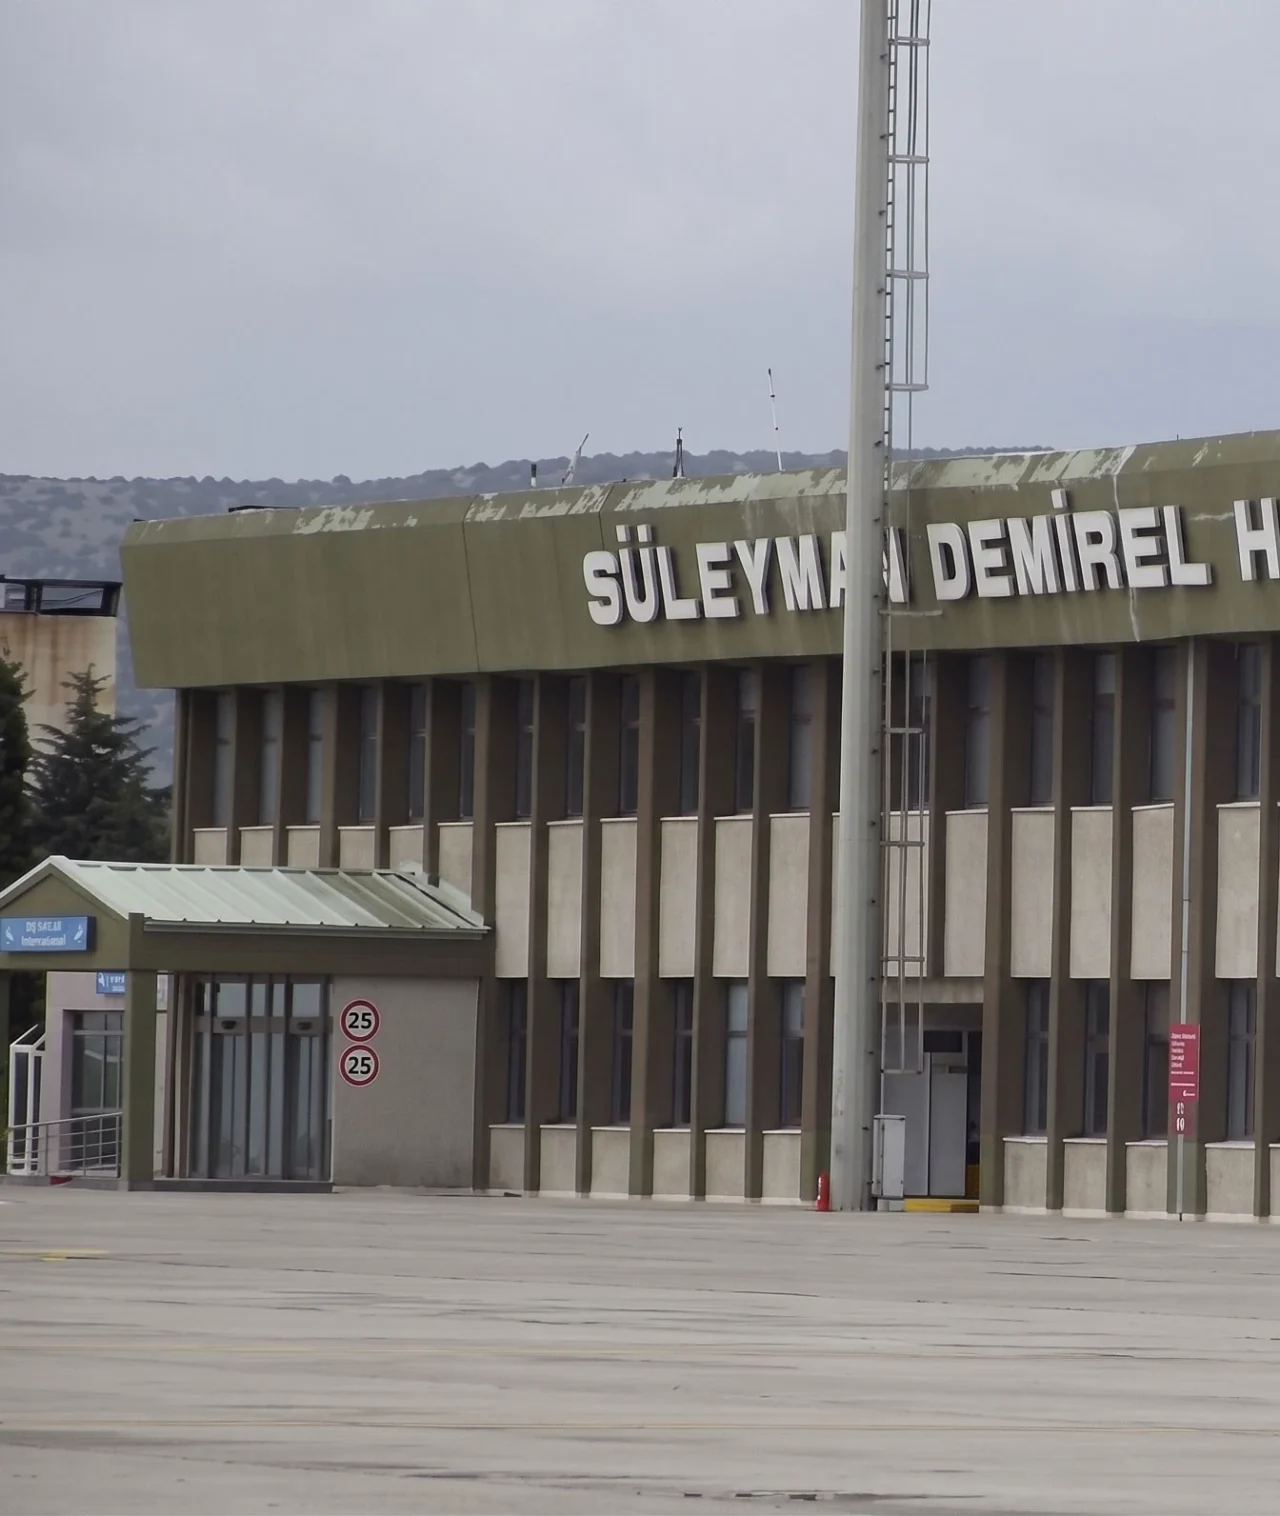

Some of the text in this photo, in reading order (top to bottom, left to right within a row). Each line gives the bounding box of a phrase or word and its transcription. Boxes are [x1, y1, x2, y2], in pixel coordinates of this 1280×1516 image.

[926, 487, 1212, 600] DEMİREL
[348, 1012, 372, 1029] 25
[348, 1056, 371, 1075] 25
